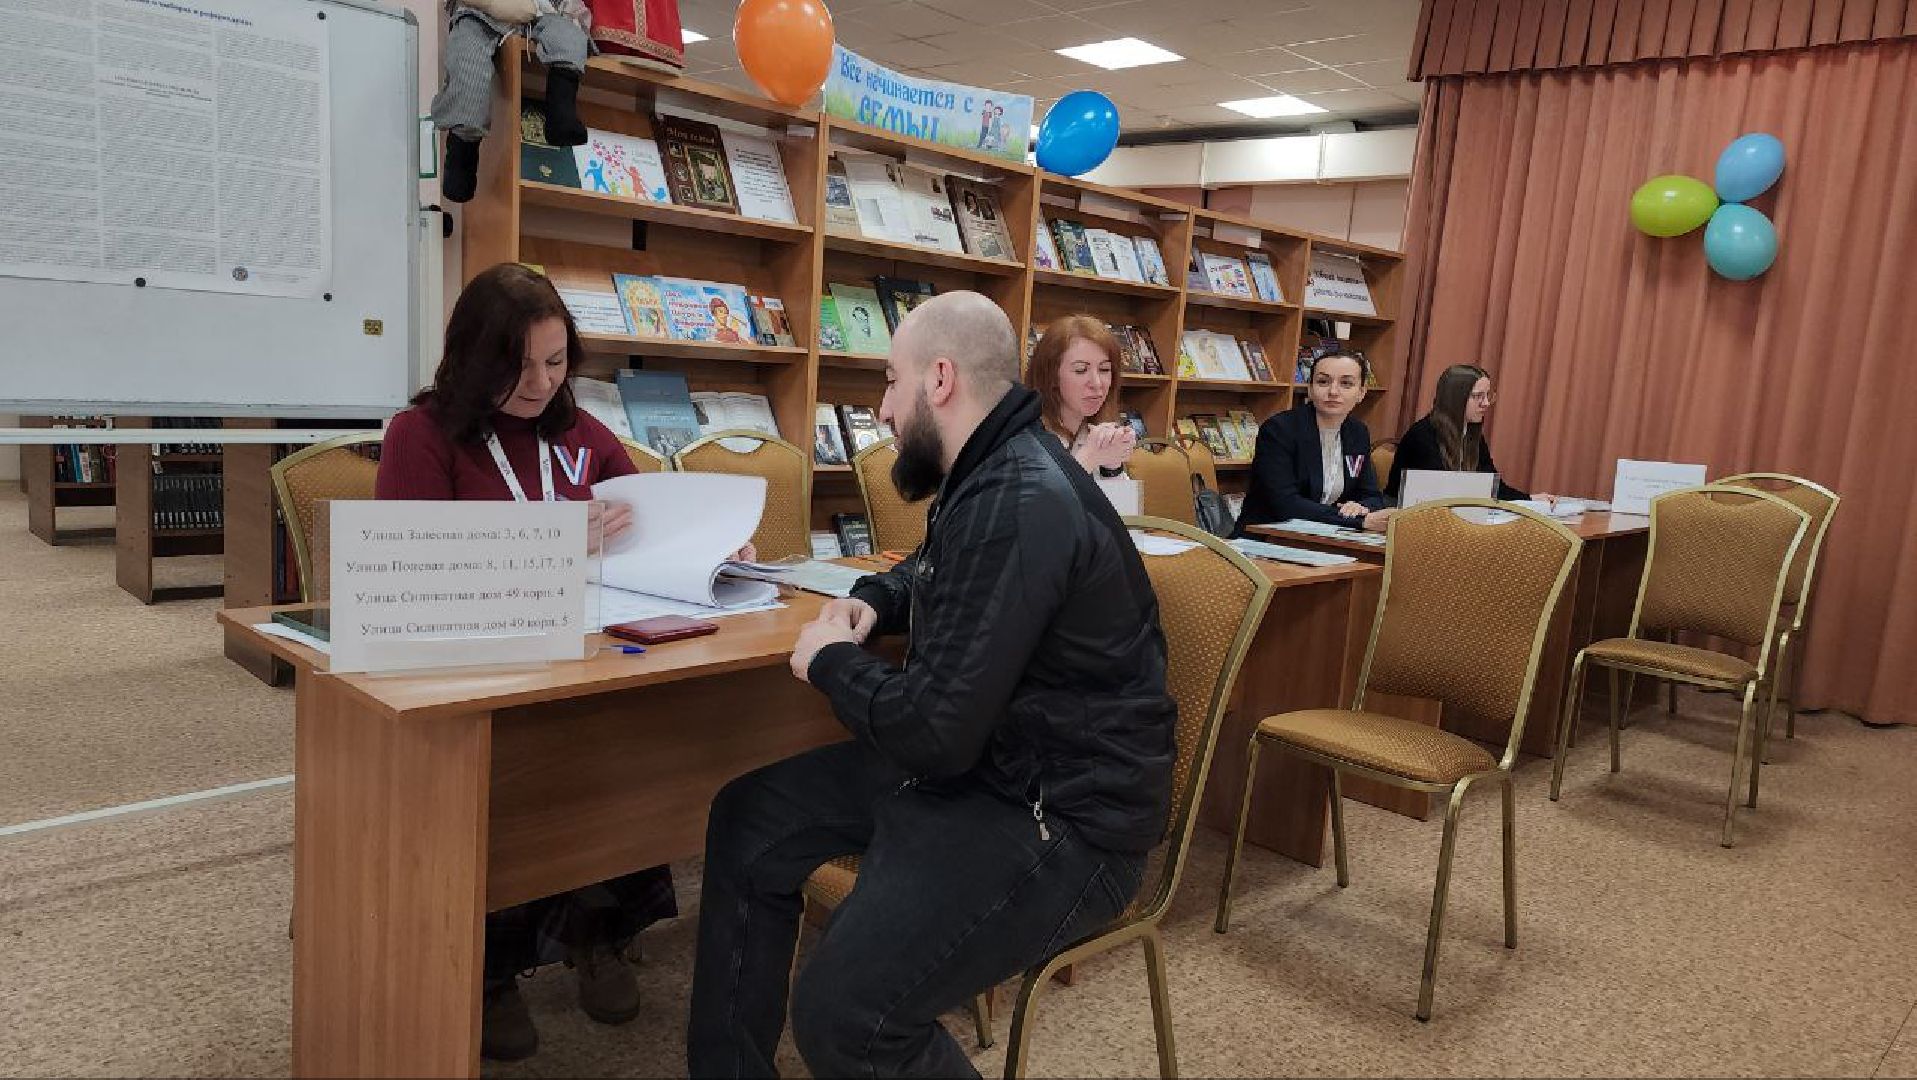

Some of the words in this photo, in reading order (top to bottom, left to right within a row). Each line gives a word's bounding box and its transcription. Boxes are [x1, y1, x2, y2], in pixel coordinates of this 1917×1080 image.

[840, 52, 862, 83] Все
[866, 70, 955, 110] начинается
[963, 95, 974, 113] с
[361, 529, 403, 541] Улица
[466, 531, 501, 541] дома:
[518, 528, 529, 540] 6,
[533, 527, 543, 540] 7,
[548, 527, 561, 538] 10
[346, 560, 387, 573] Улица
[392, 559, 445, 572] Полевая
[448, 561, 482, 572] дома:
[355, 591, 397, 604] Улица
[479, 591, 502, 601] дом
[505, 587, 520, 598] 49
[556, 586, 565, 597] 4
[361, 623, 402, 636] Улица
[484, 621, 507, 631] дом
[509, 617, 525, 628] 49
[562, 614, 570, 627] 5
